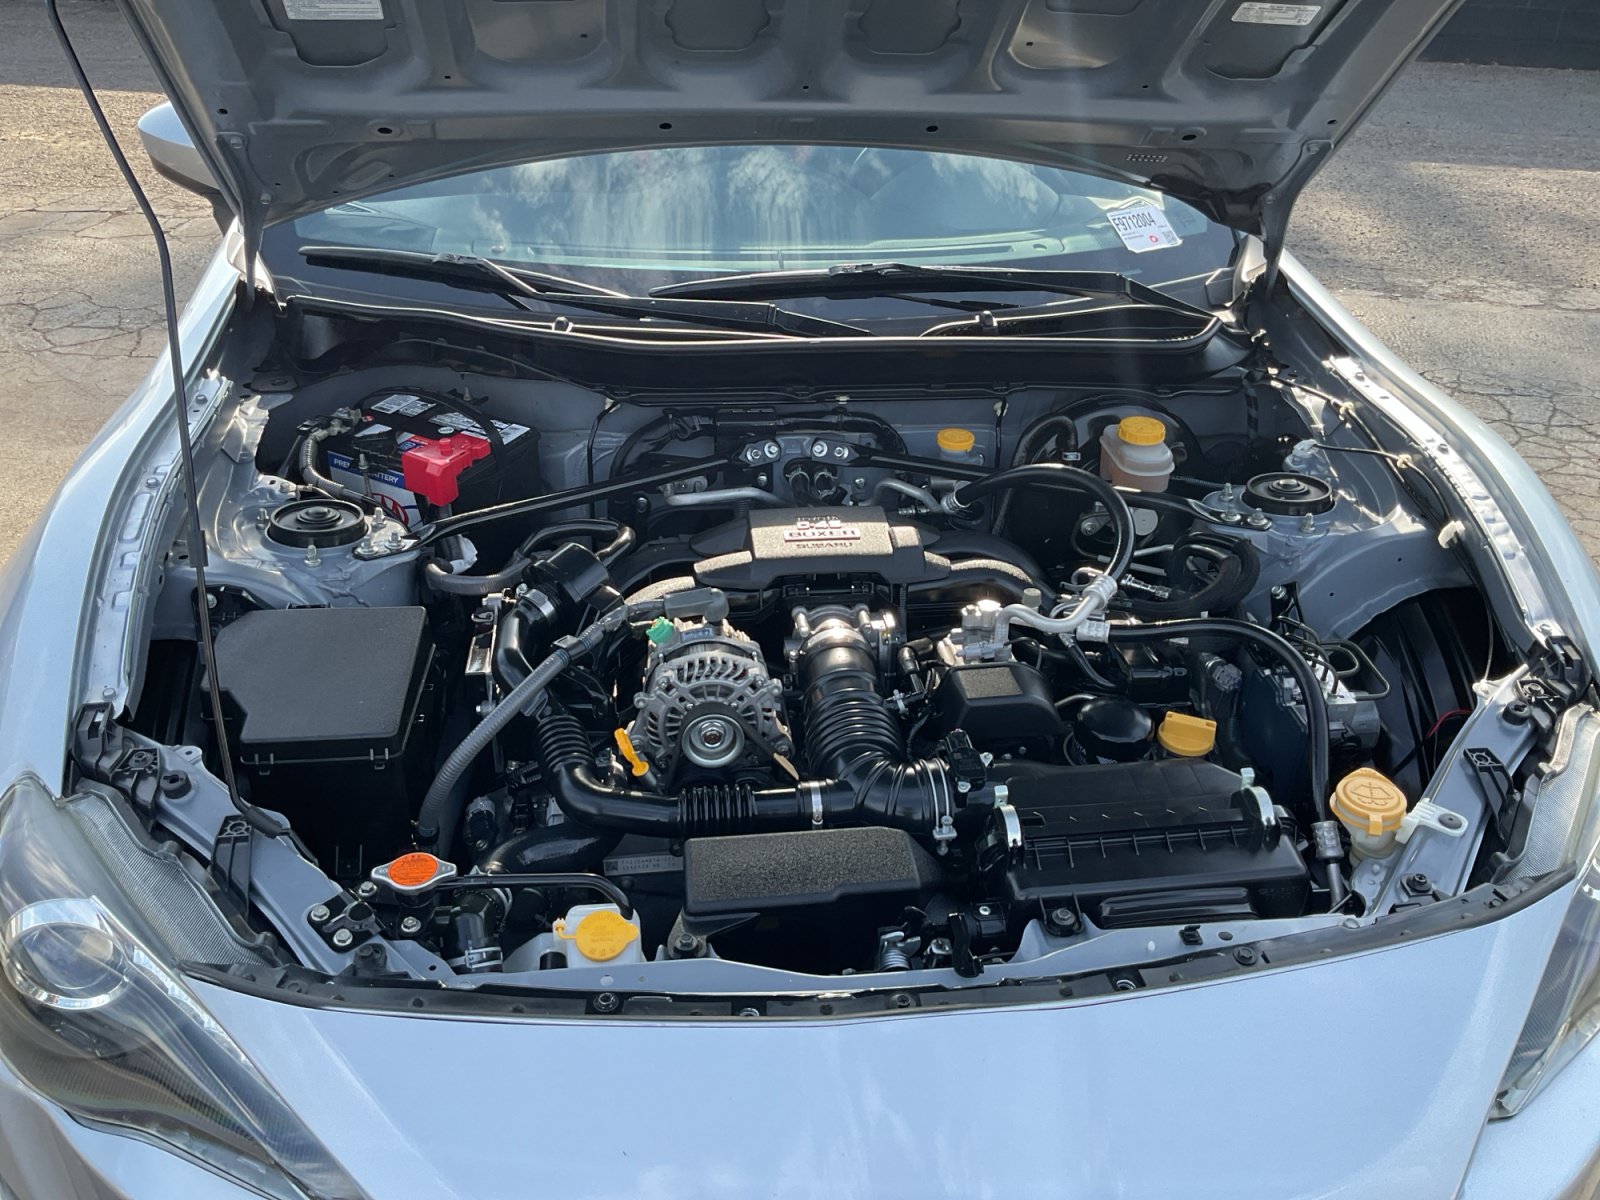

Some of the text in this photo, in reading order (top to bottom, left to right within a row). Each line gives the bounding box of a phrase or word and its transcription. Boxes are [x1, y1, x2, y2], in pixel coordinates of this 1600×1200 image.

[1112, 212, 1156, 232] F9712004
[374, 472, 399, 484] TTERY
[788, 530, 857, 538] BOXER
